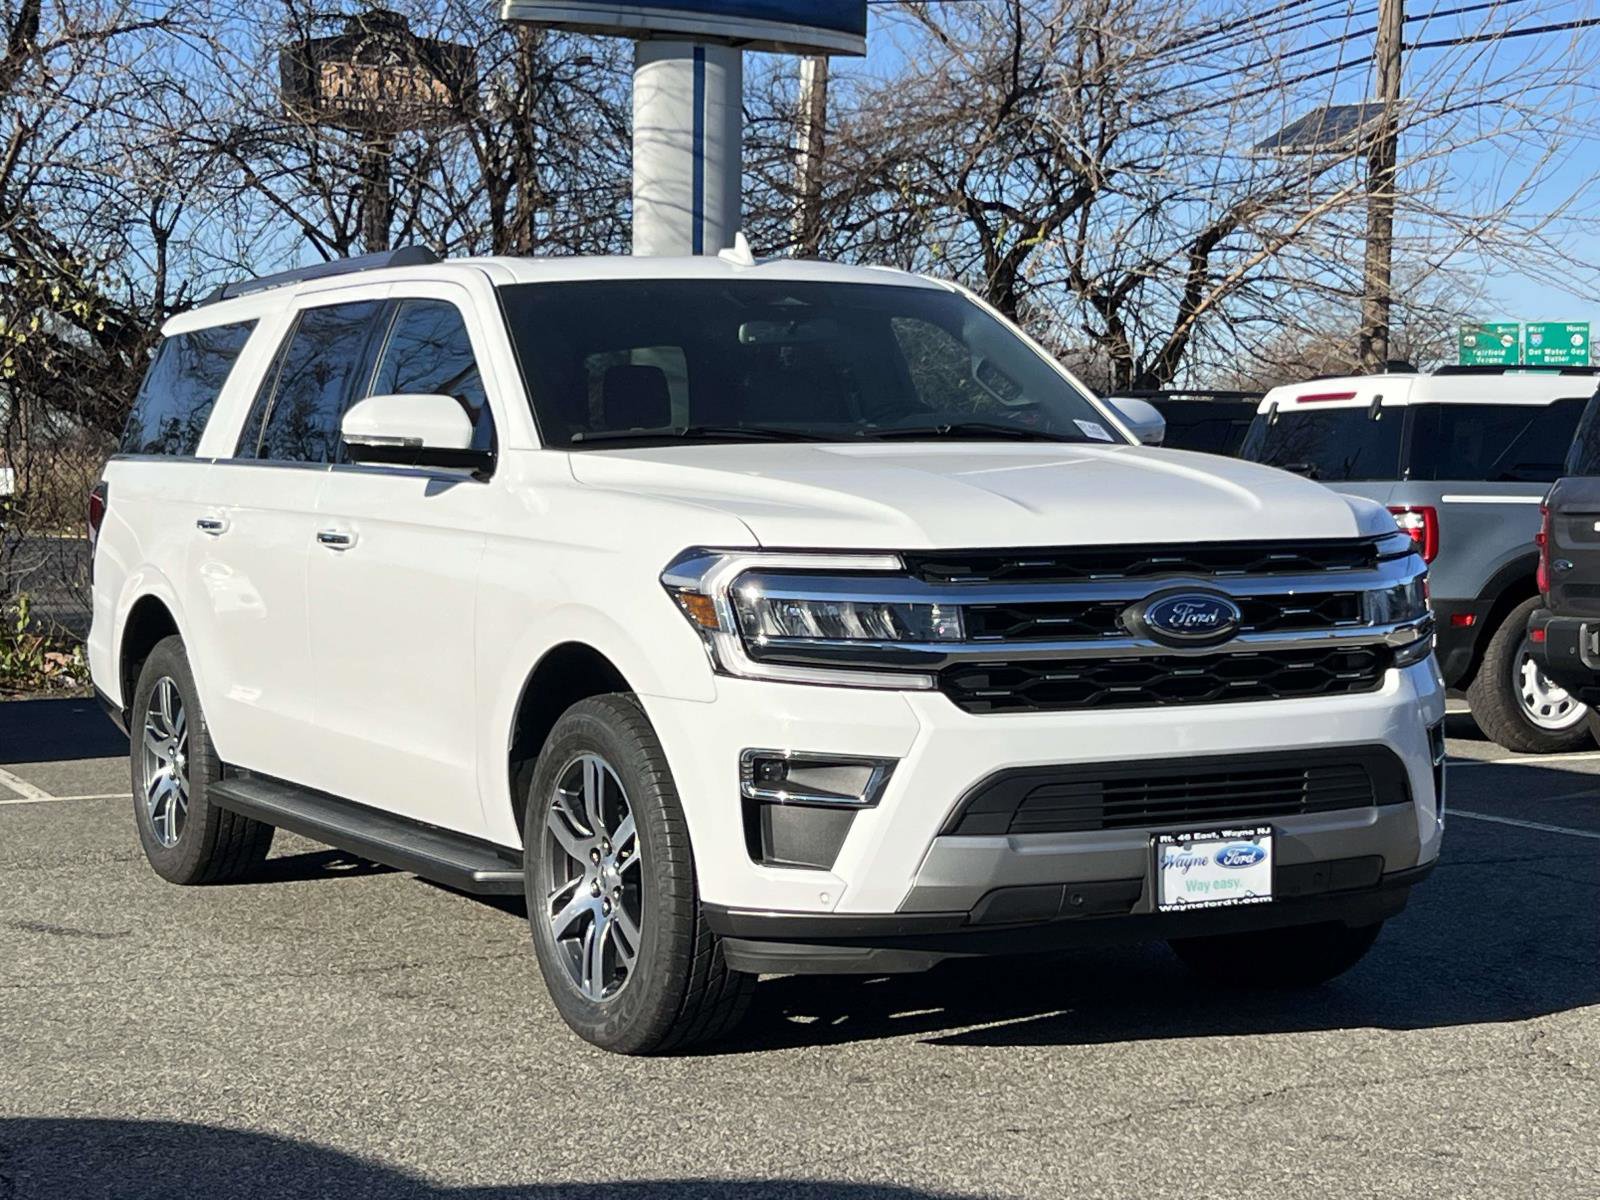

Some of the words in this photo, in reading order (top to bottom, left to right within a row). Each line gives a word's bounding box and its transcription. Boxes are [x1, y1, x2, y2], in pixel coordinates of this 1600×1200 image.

[1169, 602, 1219, 626] Ford
[1161, 852, 1208, 875] Wayne
[1223, 847, 1256, 865] Ford
[1186, 880, 1211, 893] Way
